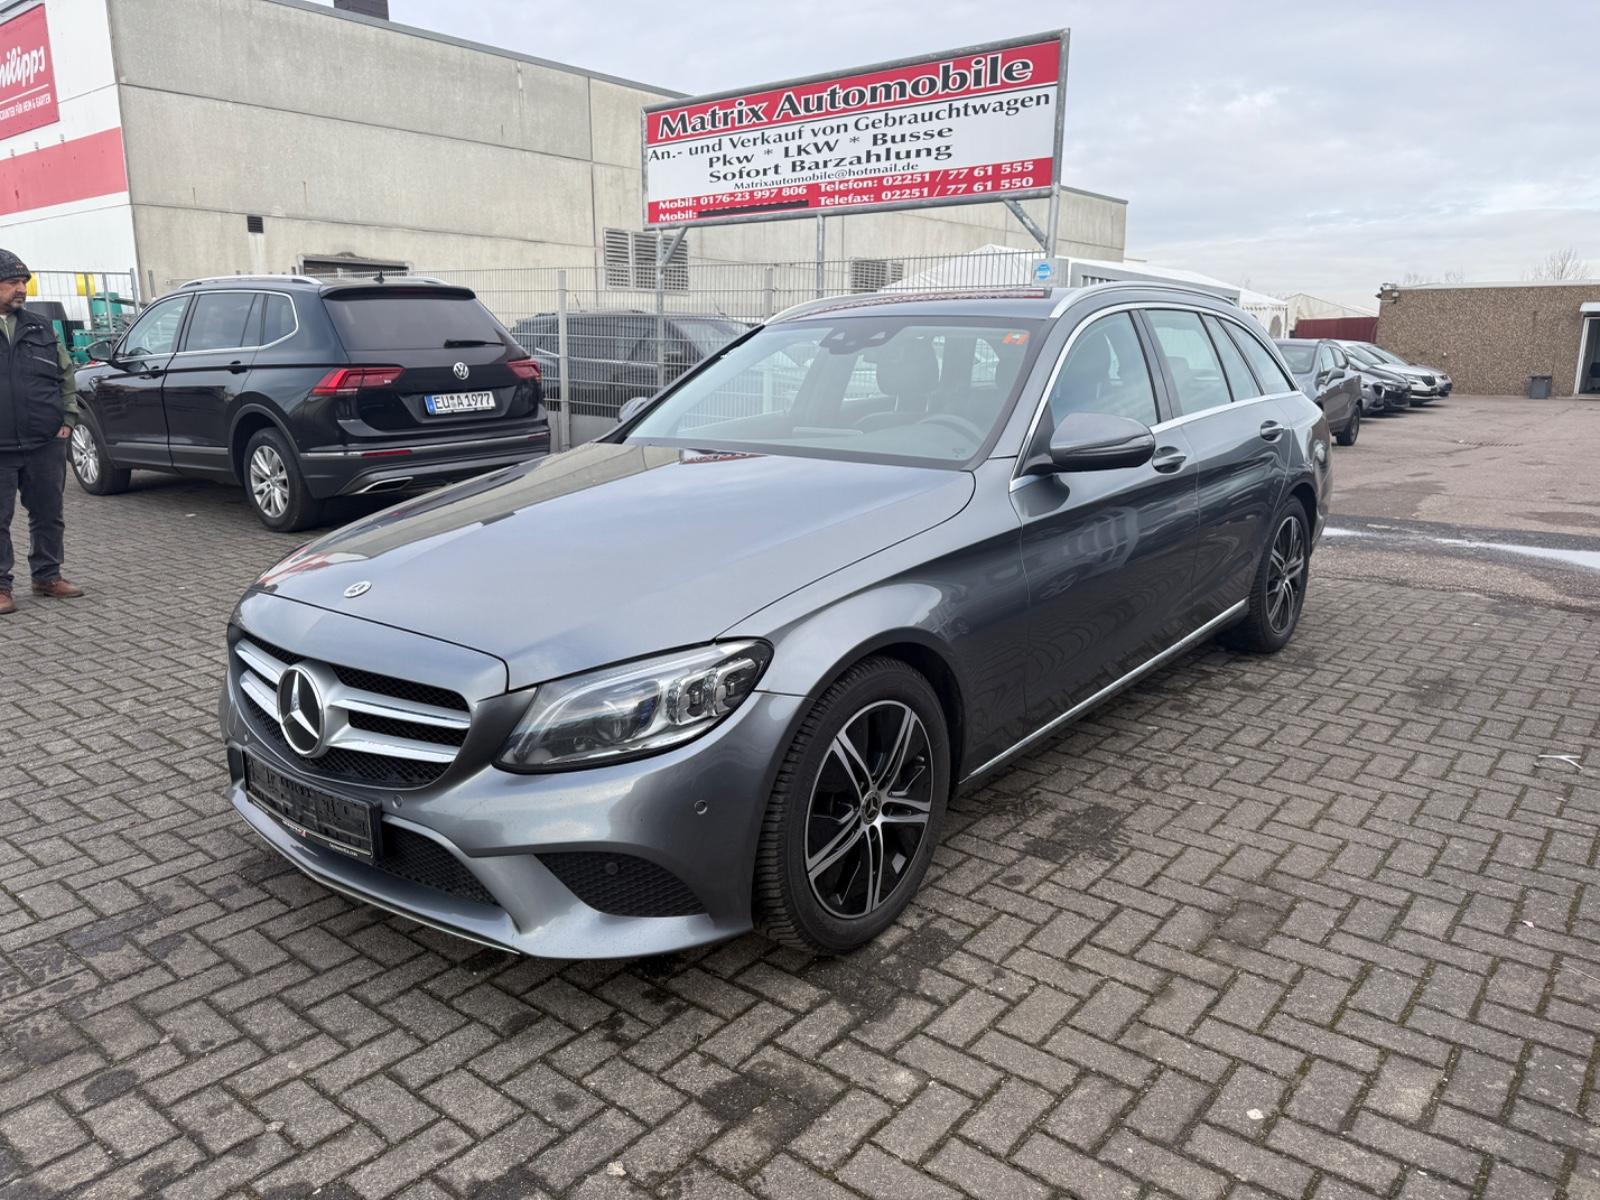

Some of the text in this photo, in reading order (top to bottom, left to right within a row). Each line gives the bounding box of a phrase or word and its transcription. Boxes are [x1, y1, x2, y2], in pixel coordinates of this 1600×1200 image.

[658, 53, 1034, 140] Matrix Automobile
[649, 93, 1051, 162] An.- und Verkauf von Gebrauchtwagen
[708, 126, 954, 168] Pkw LKW Busse
[708, 143, 953, 184] Sofort Barzahlung
[733, 162, 919, 190] Matrixautomobile@hotmail.de
[819, 177, 878, 193] Telefon:
[882, 173, 930, 187] 02251
[948, 169, 967, 180] 77
[973, 165, 993, 177] 61
[1000, 161, 1034, 175] 555
[658, 198, 697, 210] Mobil:
[700, 191, 750, 206] 0176-23
[754, 188, 777, 200] 997
[781, 185, 808, 196] 806
[818, 193, 875, 206] Telefax:
[881, 187, 929, 200] 02251
[946, 184, 966, 195] 77
[973, 181, 993, 192] 61
[1000, 176, 1034, 189] 550
[658, 210, 697, 222] Mobil:
[433, 395, 450, 409] EU
